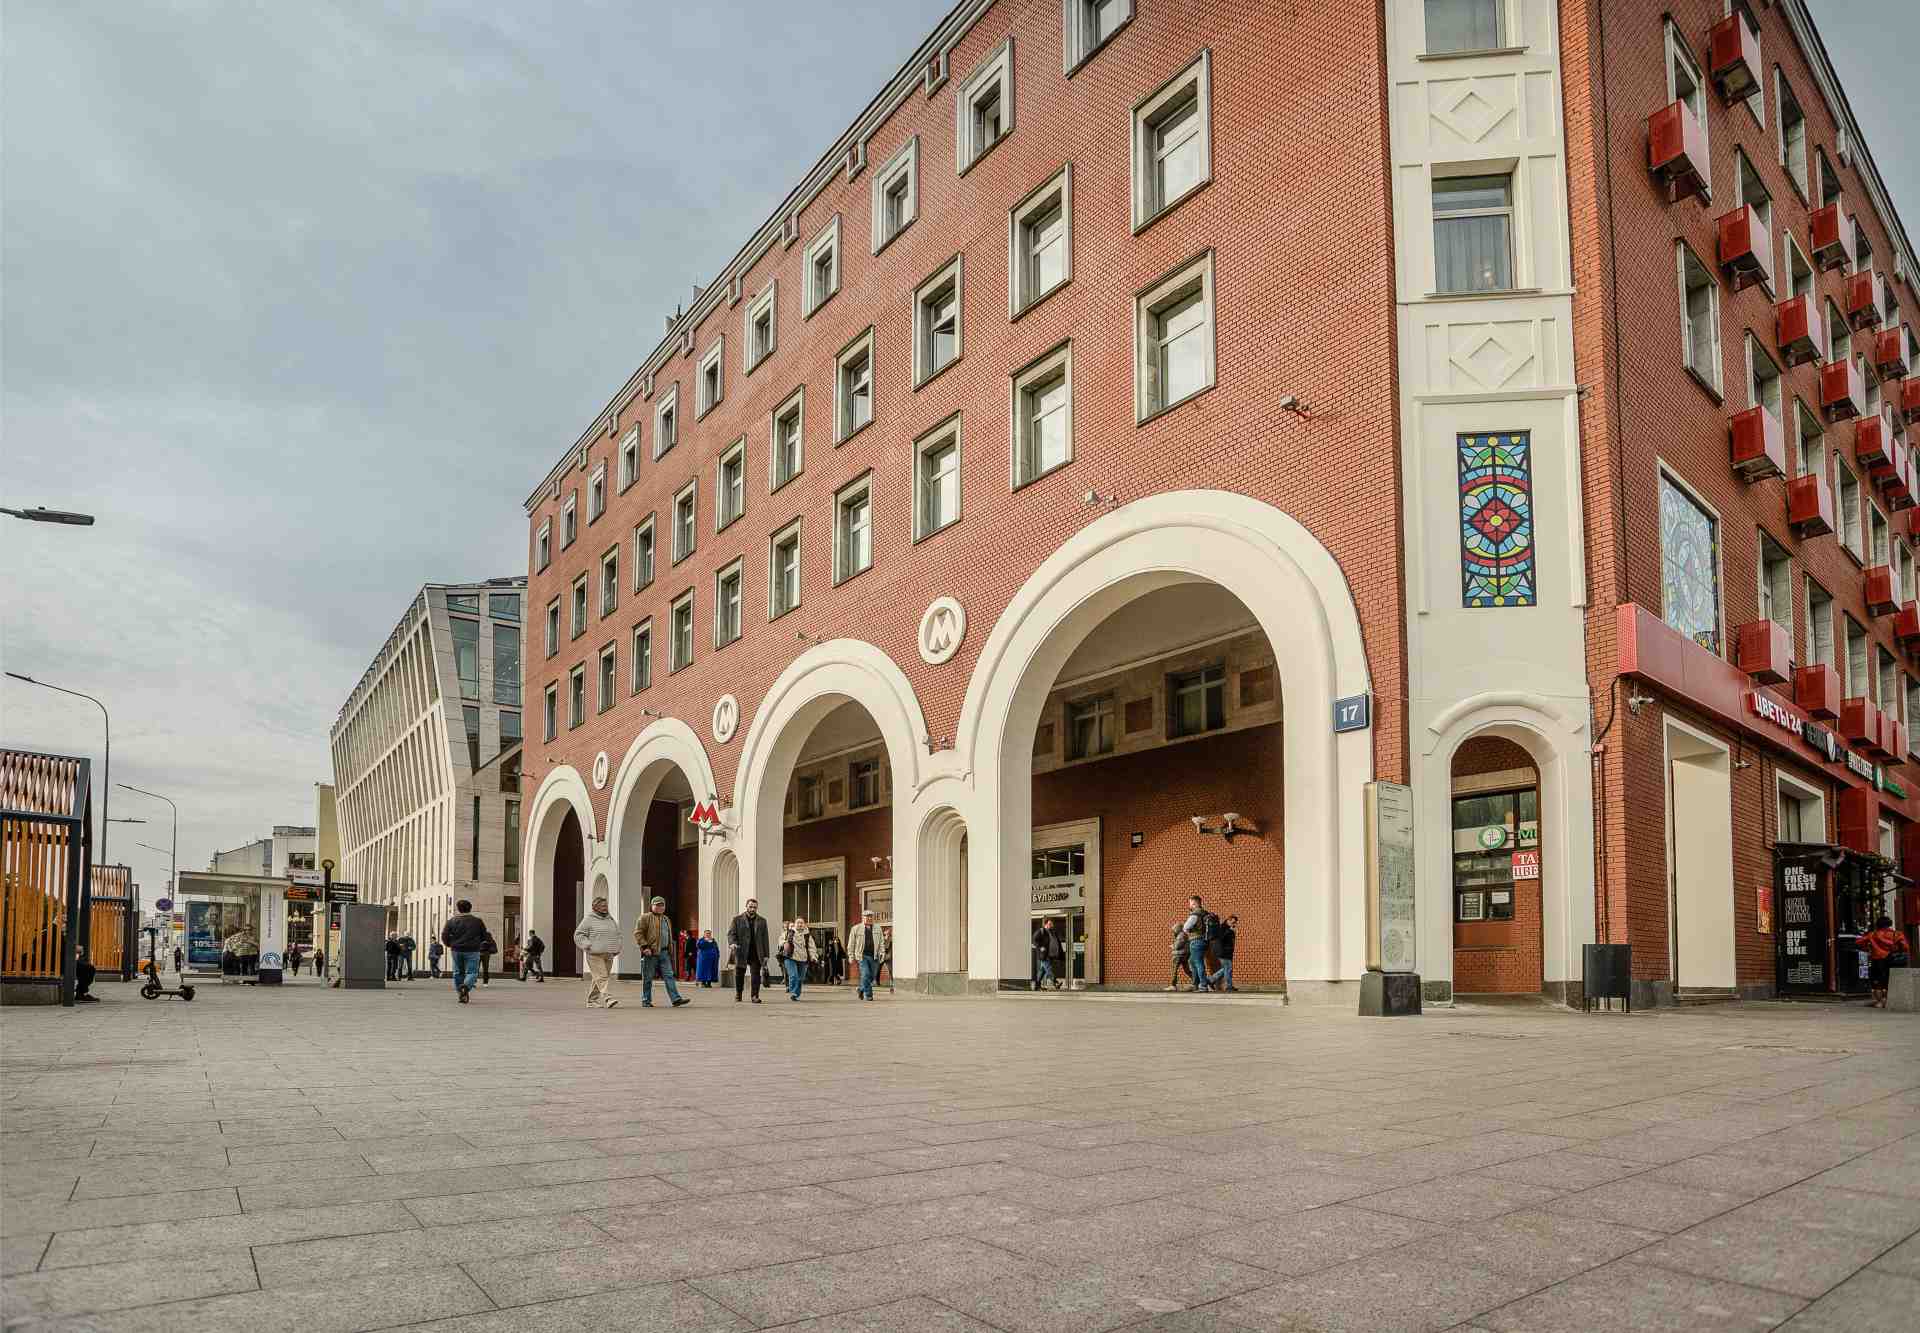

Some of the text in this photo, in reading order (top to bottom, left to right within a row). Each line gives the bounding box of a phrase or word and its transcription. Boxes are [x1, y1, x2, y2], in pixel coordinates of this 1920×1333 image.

[1341, 704, 1359, 722] 17
[1754, 692, 1803, 735] ЦВЕТЫ 24
[690, 801, 721, 826] М
[1784, 866, 1805, 876] ONE
[1785, 873, 1817, 883] FRESH
[1784, 883, 1817, 892] TASTE
[1786, 930, 1807, 939] ONE
[1786, 939, 1800, 947] BY
[1786, 946, 1808, 955] ONE
